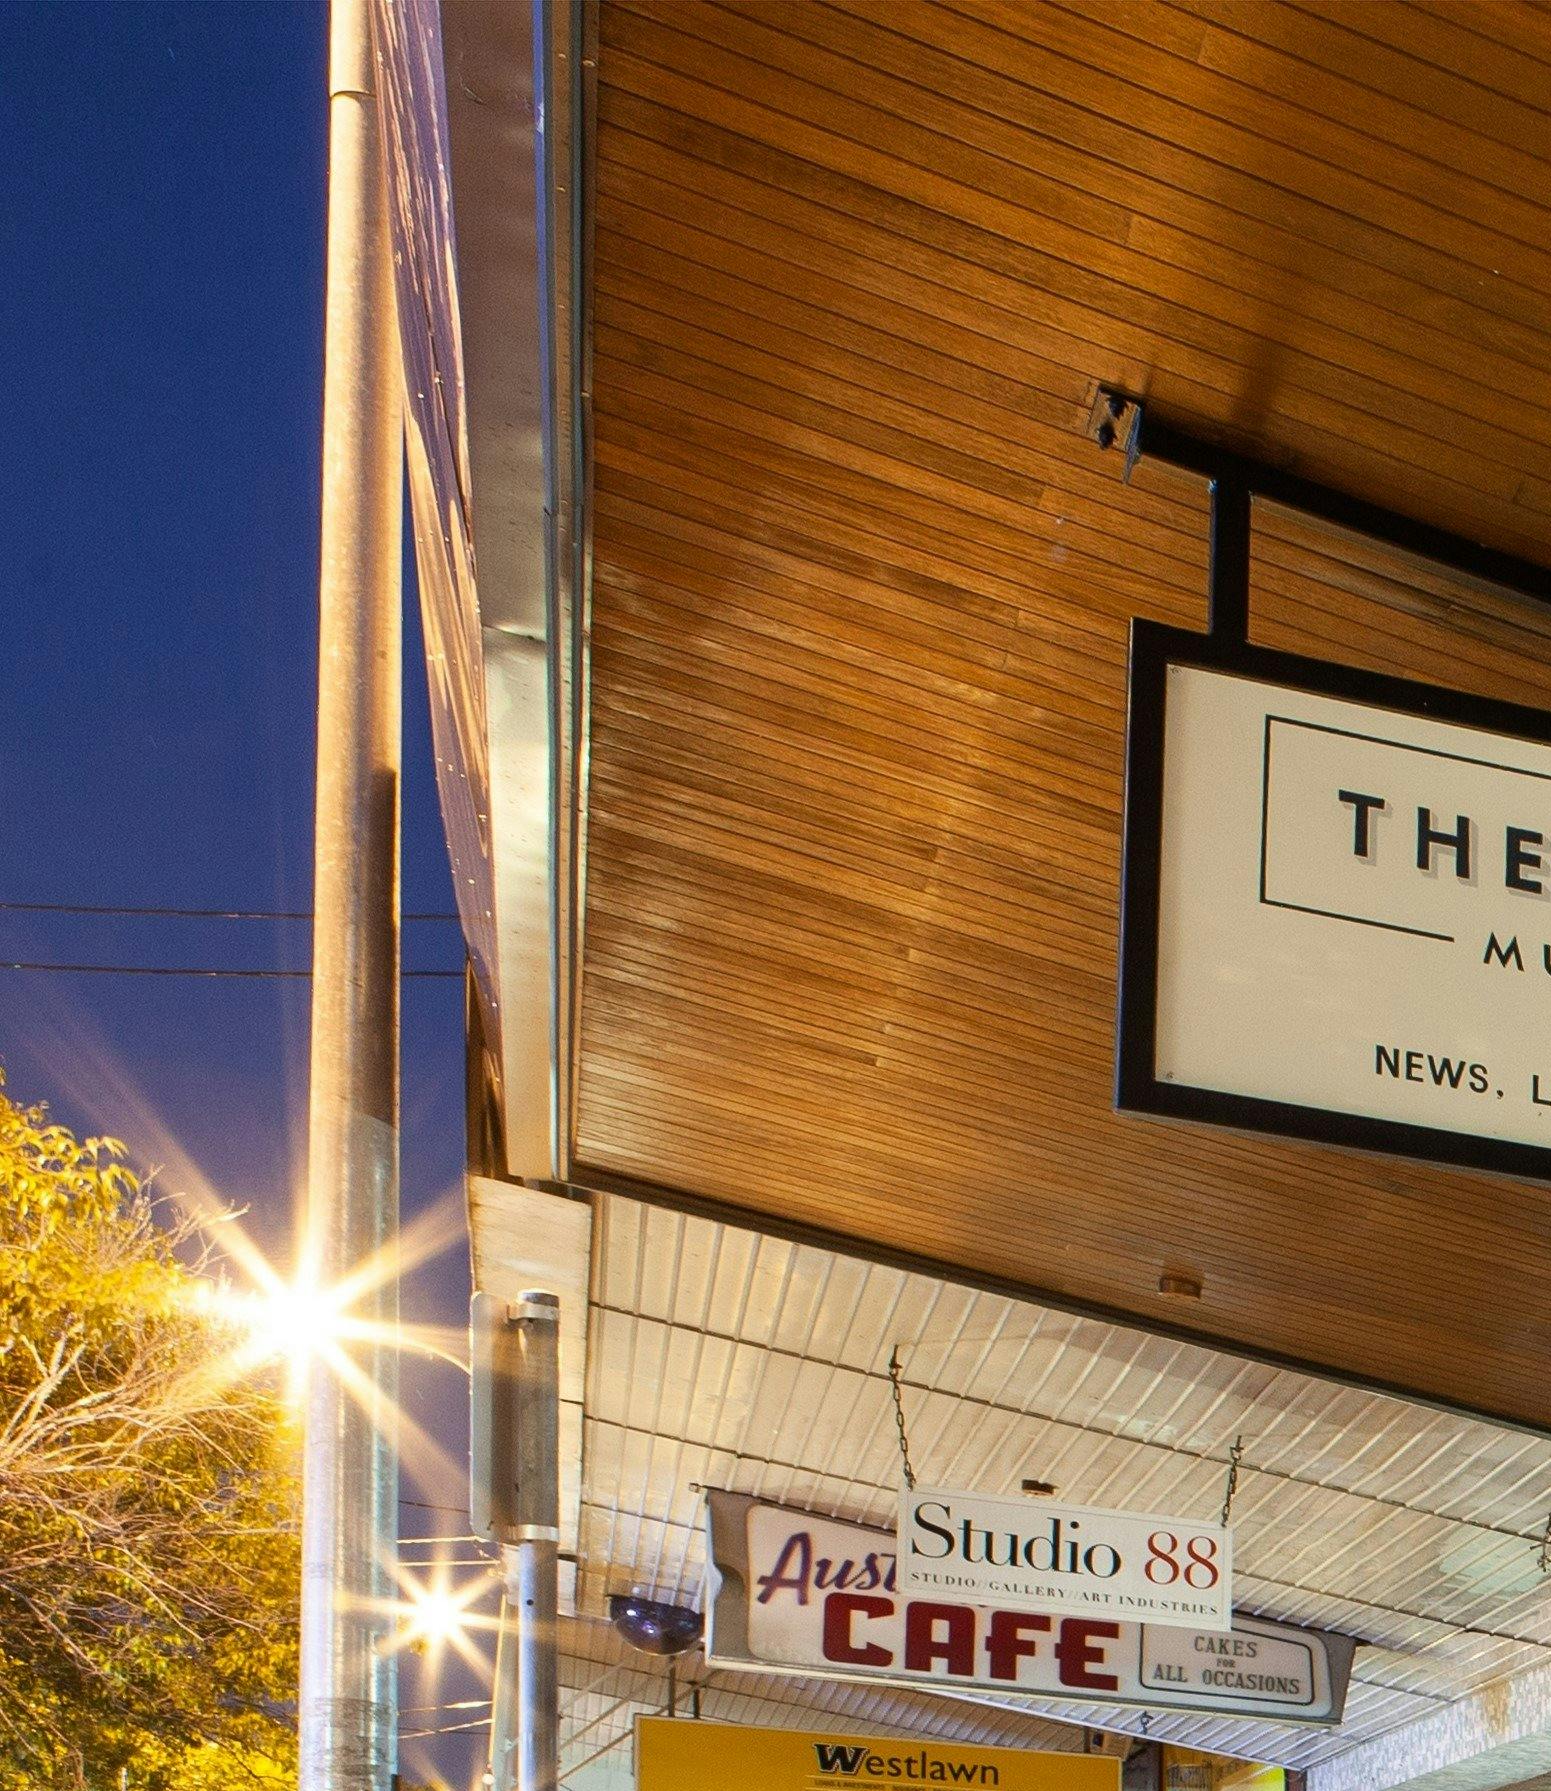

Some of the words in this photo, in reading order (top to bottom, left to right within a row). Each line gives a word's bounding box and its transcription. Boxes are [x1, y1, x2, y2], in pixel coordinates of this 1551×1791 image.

[1338, 788, 1549, 902] THE
[1374, 1044, 1505, 1100] NEWS,
[756, 1531, 897, 1607] Aust
[911, 1501, 1122, 1579] Studio
[1144, 1530, 1219, 1591] 88
[1118, 1594, 1220, 1616] INDUSTRIES
[822, 1591, 1121, 1692] CAFE
[1193, 1635, 1259, 1659] CAKES
[1153, 1664, 1188, 1684] ALL
[1202, 1666, 1301, 1696] OCCASIONS
[813, 1742, 1000, 1787] Westlawn
